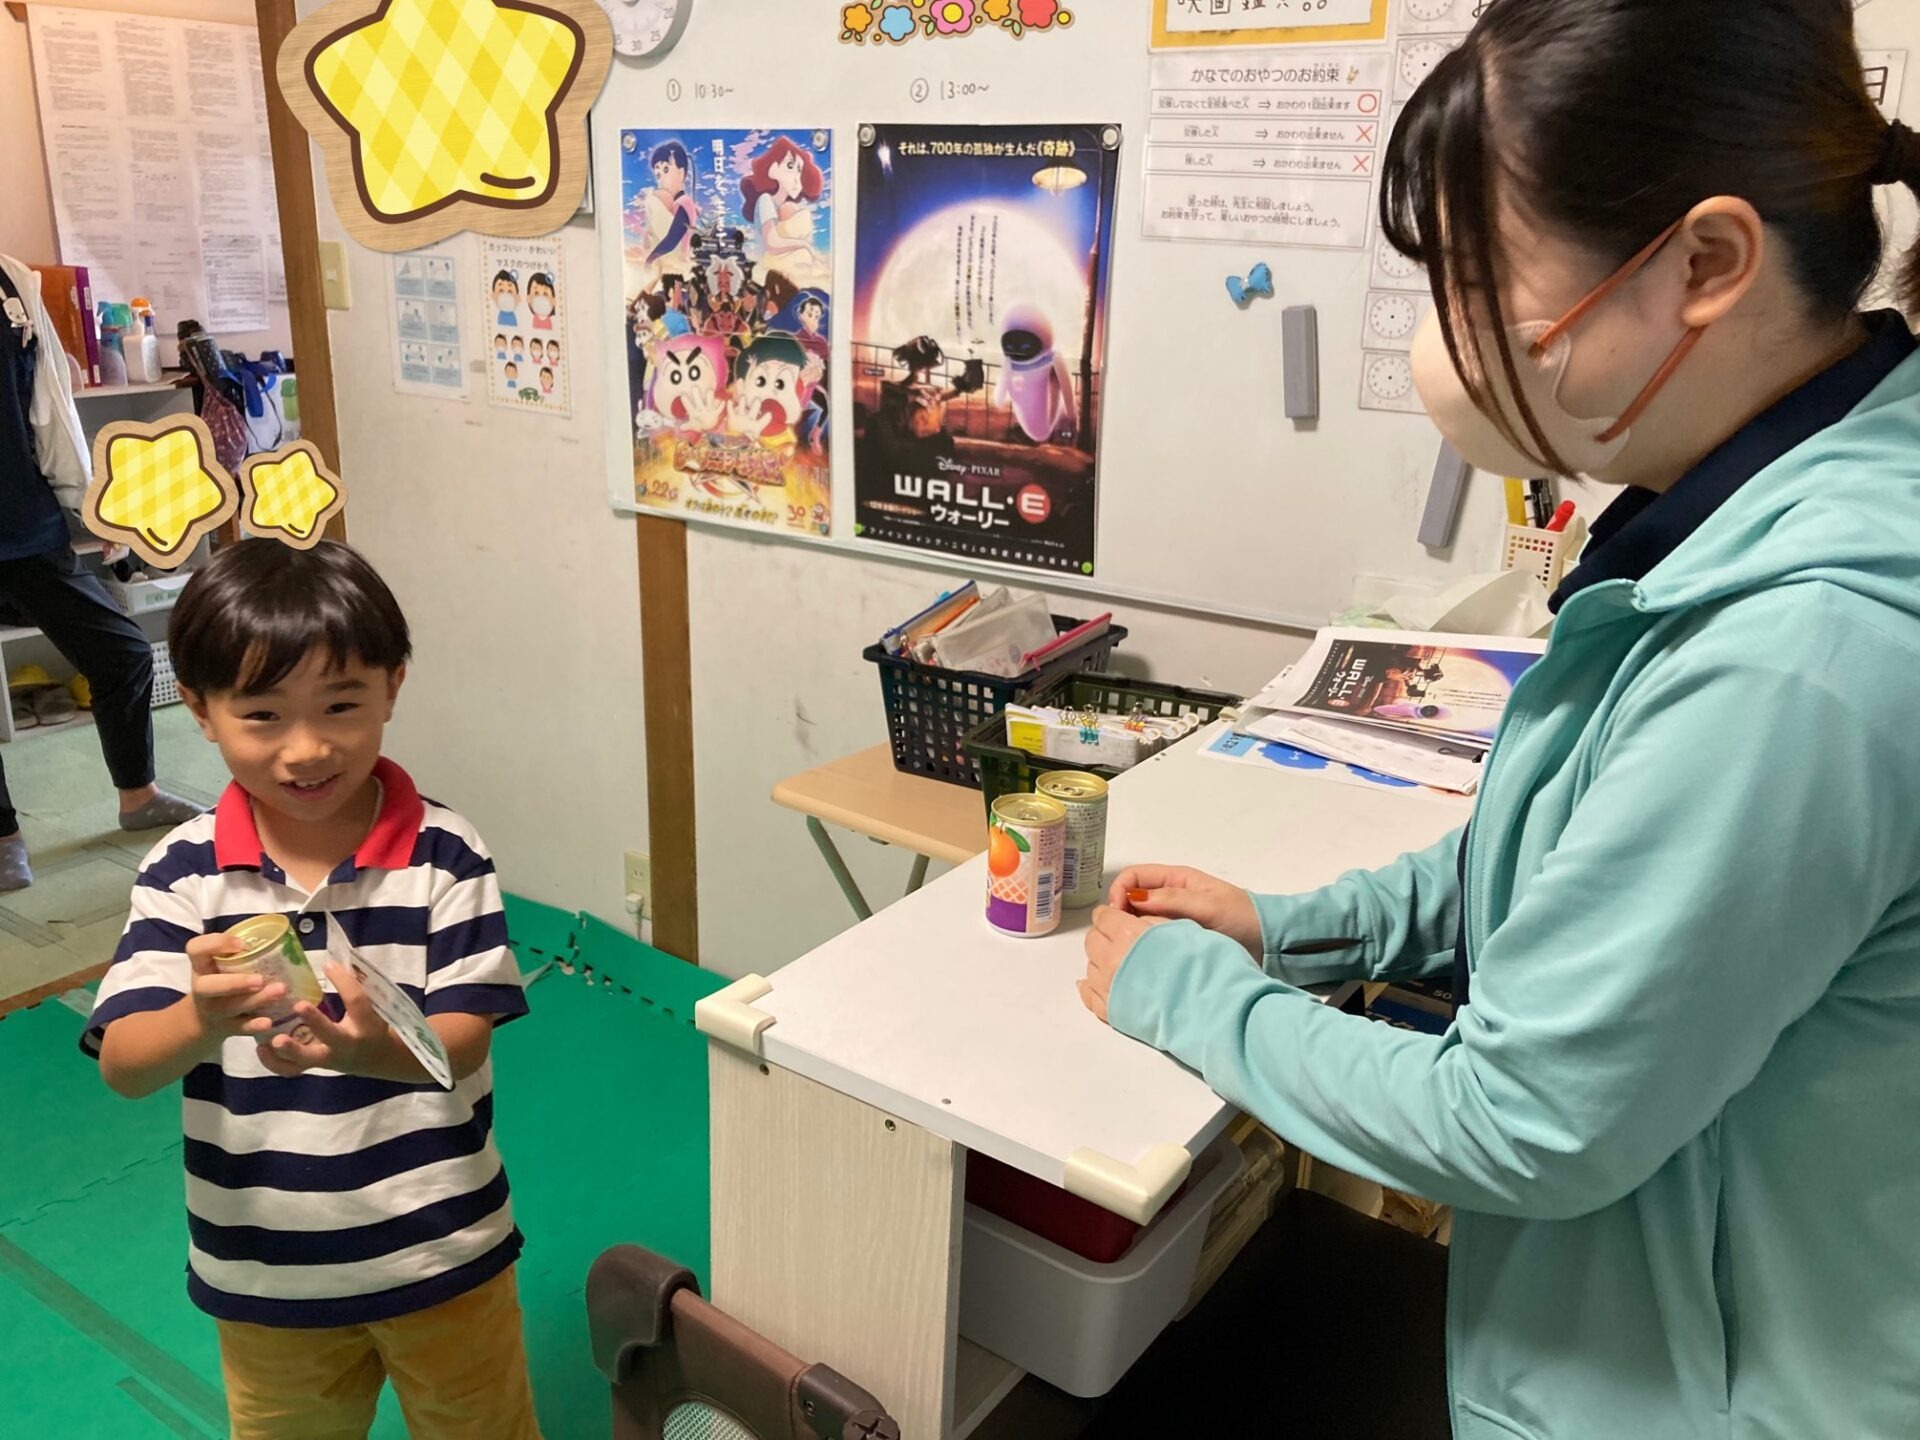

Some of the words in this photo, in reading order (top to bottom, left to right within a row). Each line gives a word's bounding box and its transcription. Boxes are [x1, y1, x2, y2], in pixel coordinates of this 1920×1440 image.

[1191, 67, 1339, 83] かなでのおやつのお約束
[971, 464, 1000, 476] PIXAR
[930, 503, 1010, 529] ウォーリー
